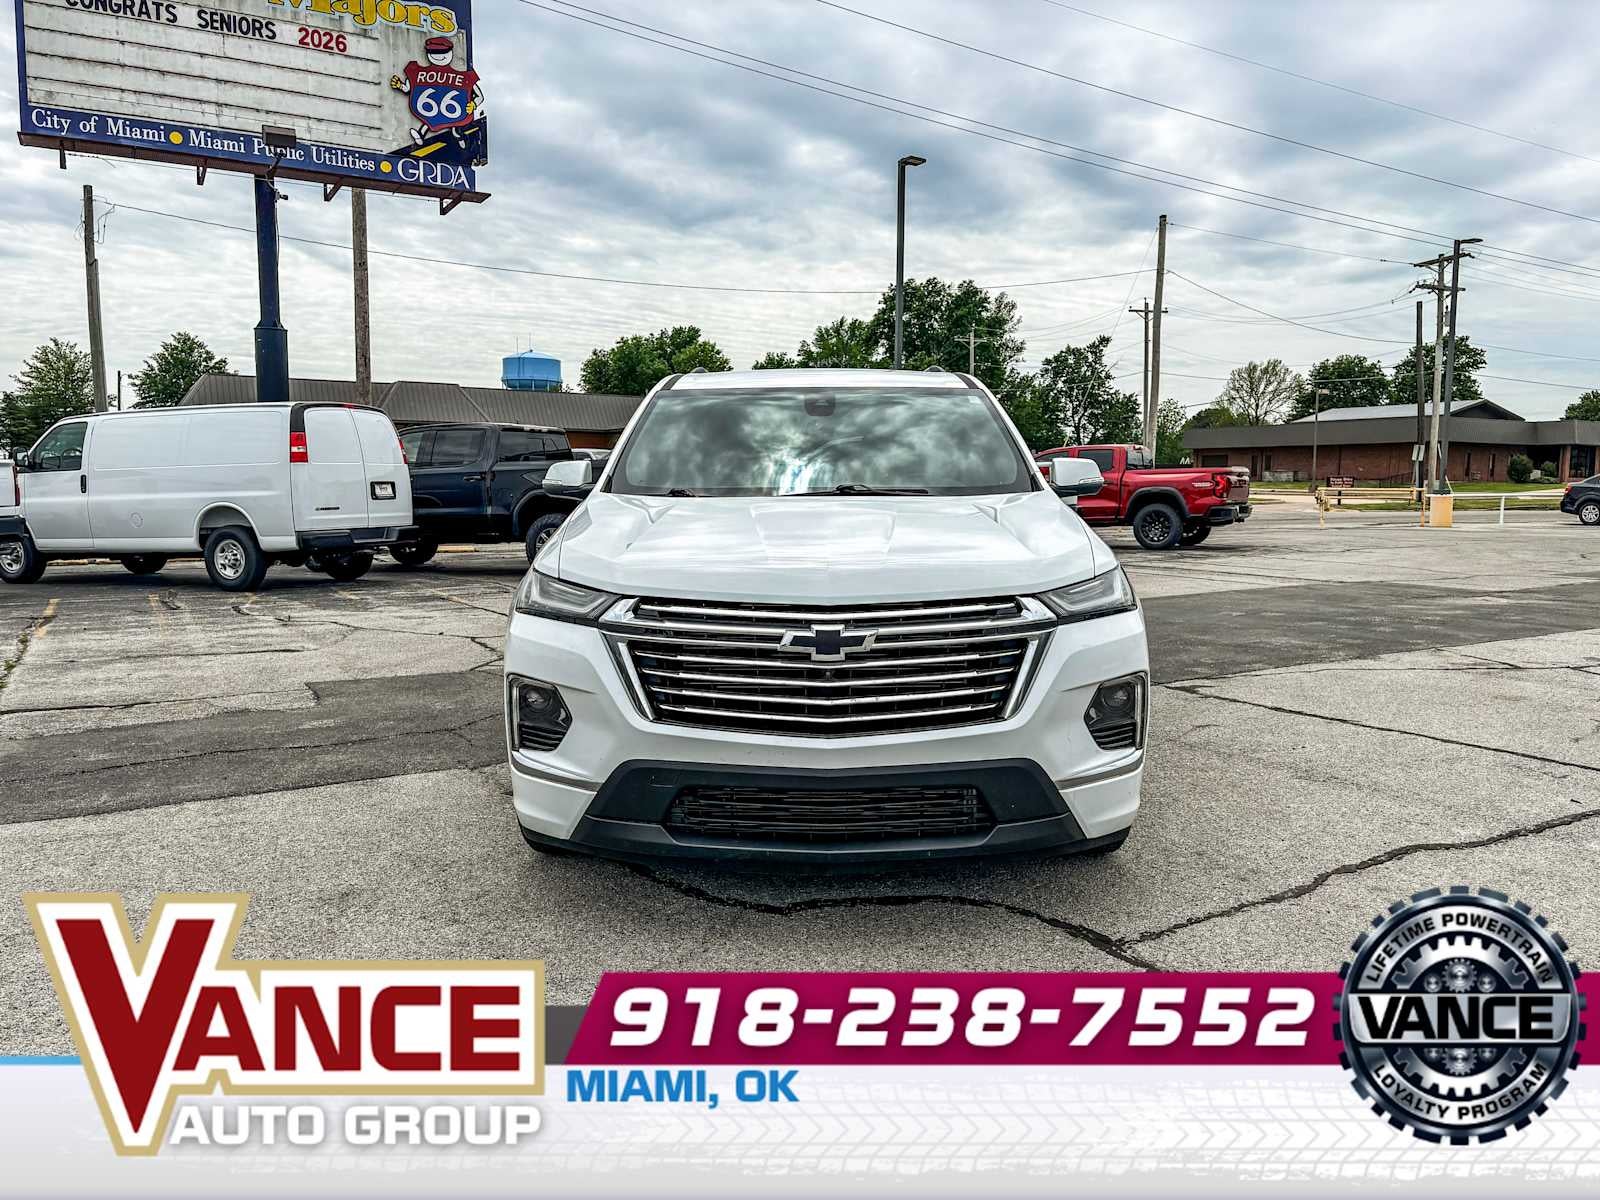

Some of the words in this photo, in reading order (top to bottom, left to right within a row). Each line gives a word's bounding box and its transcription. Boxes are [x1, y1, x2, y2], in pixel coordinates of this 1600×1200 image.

[197, 9, 277, 40] SENIORS
[298, 27, 347, 53] 2026
[268, 0, 455, 33] ajors
[417, 71, 464, 86] ROUTE
[416, 88, 462, 119] 66
[31, 108, 71, 136] City
[79, 116, 98, 134] of
[106, 117, 166, 143] Miami
[189, 129, 246, 154] Miami
[312, 145, 376, 171] Utilities
[397, 158, 470, 189] GRDA
